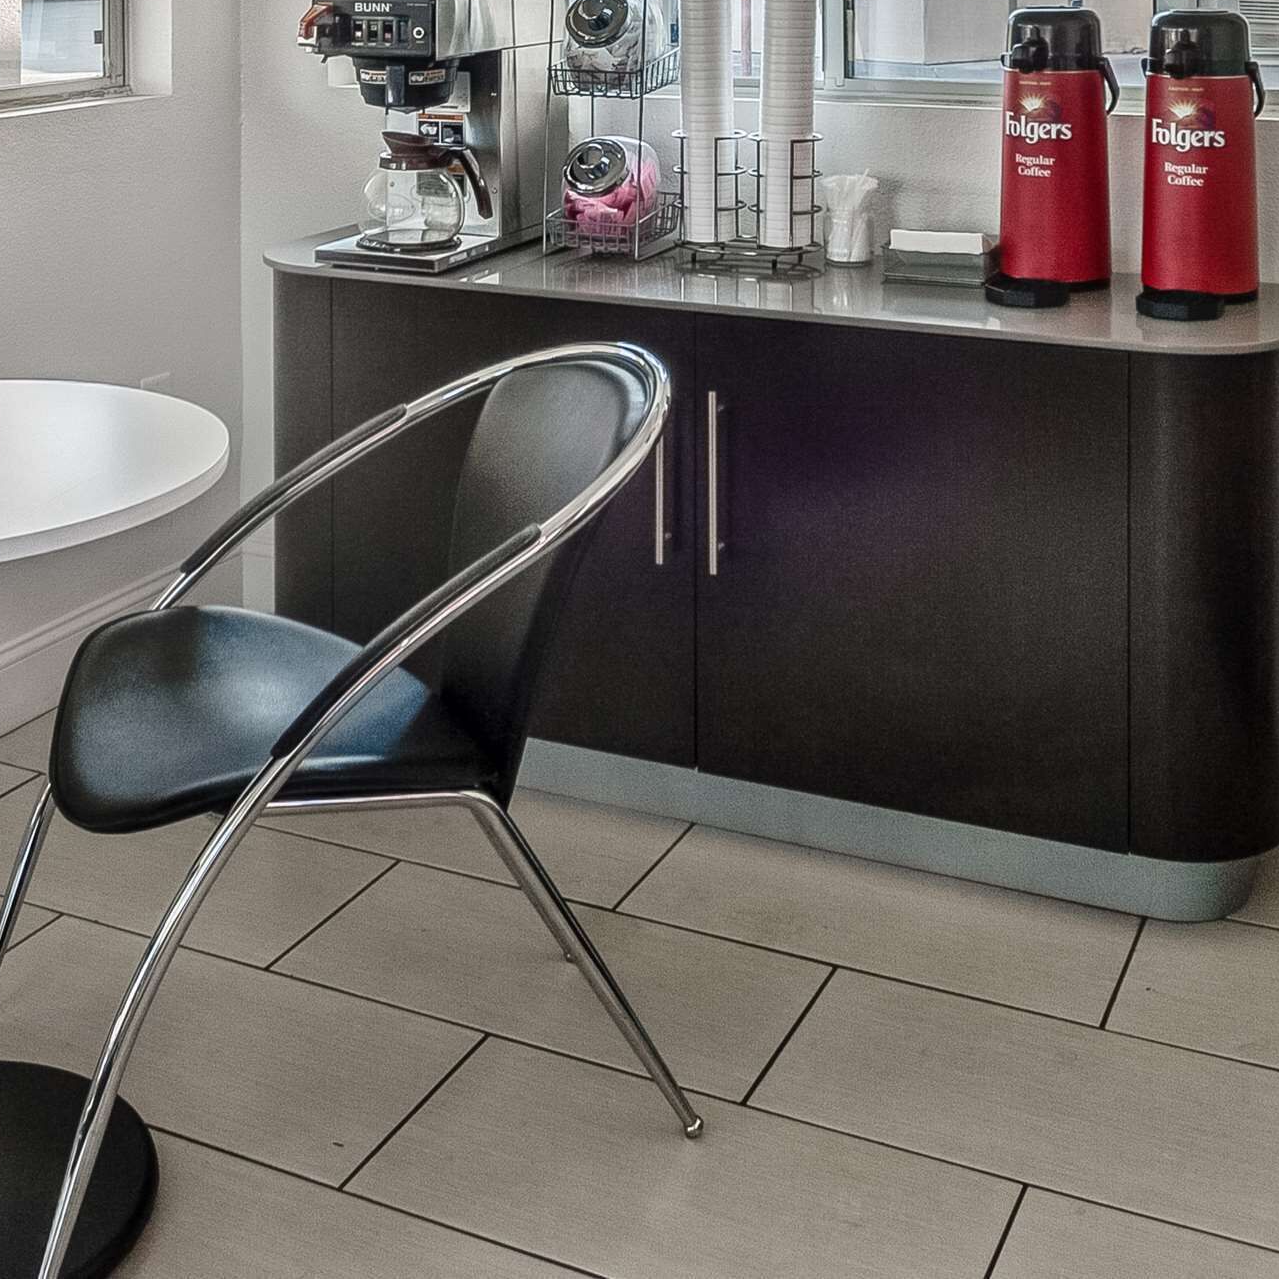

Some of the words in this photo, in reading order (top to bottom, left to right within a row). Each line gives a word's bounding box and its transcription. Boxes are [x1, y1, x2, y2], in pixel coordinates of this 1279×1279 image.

[354, 2, 391, 13] BUNN
[1005, 110, 1072, 144] Folgers
[1151, 118, 1226, 152] Folgers
[1015, 153, 1056, 167] Regular
[1018, 165, 1052, 178] Coffee
[1164, 161, 1209, 175] Regular
[1167, 174, 1205, 187] Coffee
